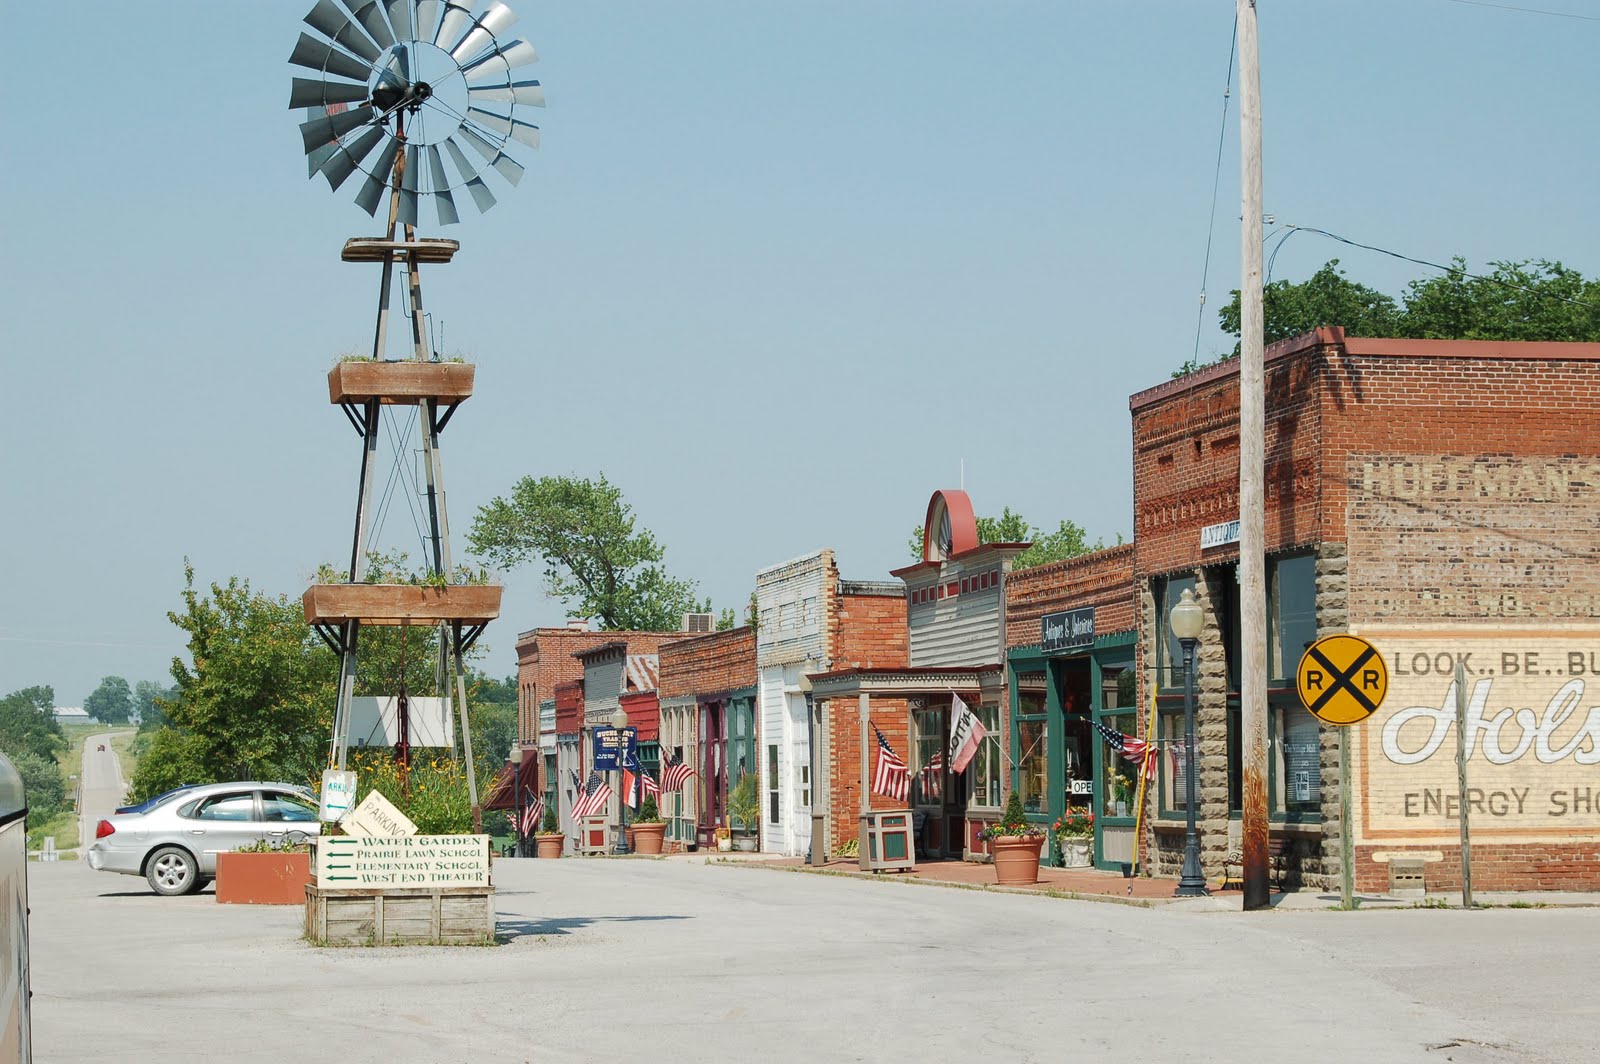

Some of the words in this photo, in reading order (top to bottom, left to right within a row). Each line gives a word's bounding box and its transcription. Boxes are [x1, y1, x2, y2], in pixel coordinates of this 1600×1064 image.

[1042, 618, 1064, 647] Antiques
[1064, 617, 1070, 638] &
[1307, 670, 1323, 690] R
[1363, 669, 1380, 690] R
[1073, 782, 1093, 793] OPE
[1404, 787, 1530, 820] ENERGY
[362, 837, 413, 847] WATER
[419, 837, 481, 846] GARDEN
[357, 850, 401, 859] PRAIRIE
[405, 849, 436, 858] LAWN
[439, 849, 484, 858] SCHOOL
[355, 862, 431, 871] ELEMENTARY
[435, 861, 482, 870] SCHOOL
[361, 873, 397, 883] WEST
[401, 873, 425, 883] END
[429, 872, 484, 882] THEATER
